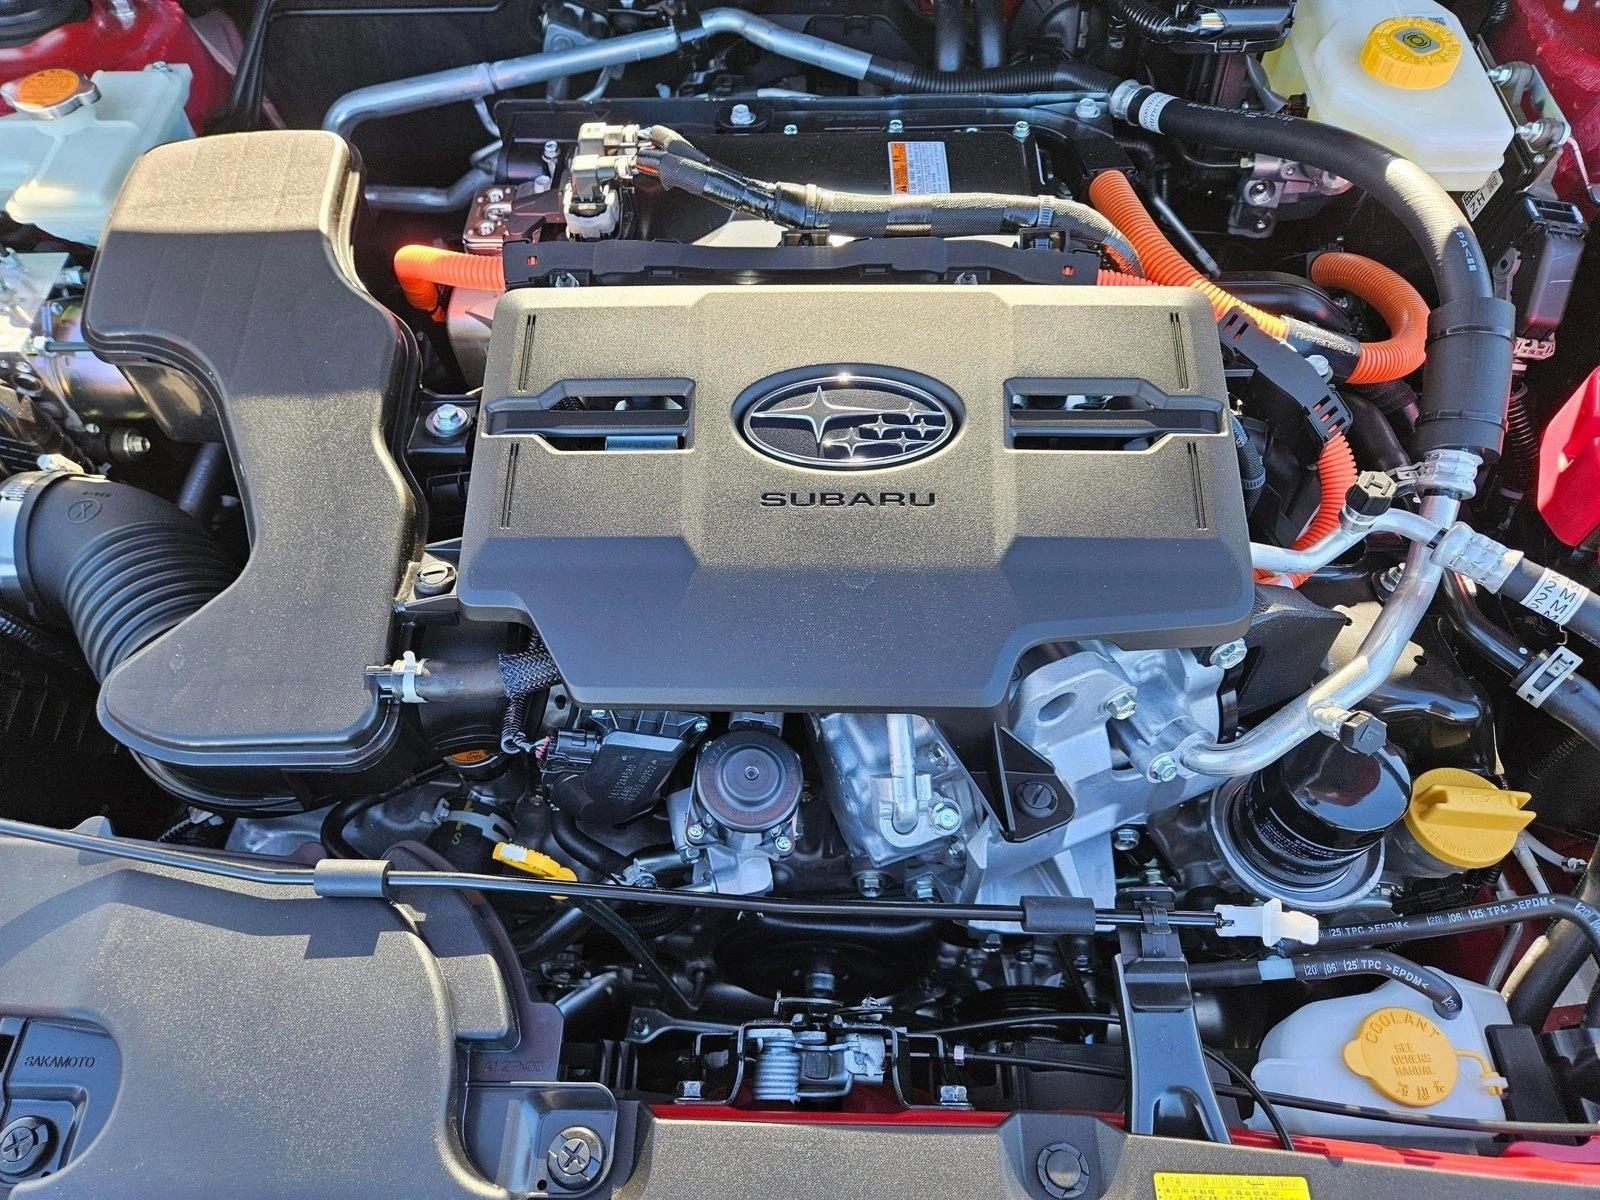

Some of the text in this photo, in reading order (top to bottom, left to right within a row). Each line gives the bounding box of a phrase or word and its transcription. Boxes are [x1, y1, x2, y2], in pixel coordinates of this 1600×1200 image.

[760, 492, 936, 507] SUBARU
[1544, 580, 1577, 603] 2 M
[1534, 592, 1568, 614] 2 M
[1345, 925, 1365, 935] TPC
[1486, 904, 1509, 916] TPC
[1361, 959, 1382, 970] TPC
[1365, 1012, 1440, 1043] COOLANT
[1394, 1042, 1413, 1053] SEE
[25, 1056, 95, 1068] SAKAMOTO
